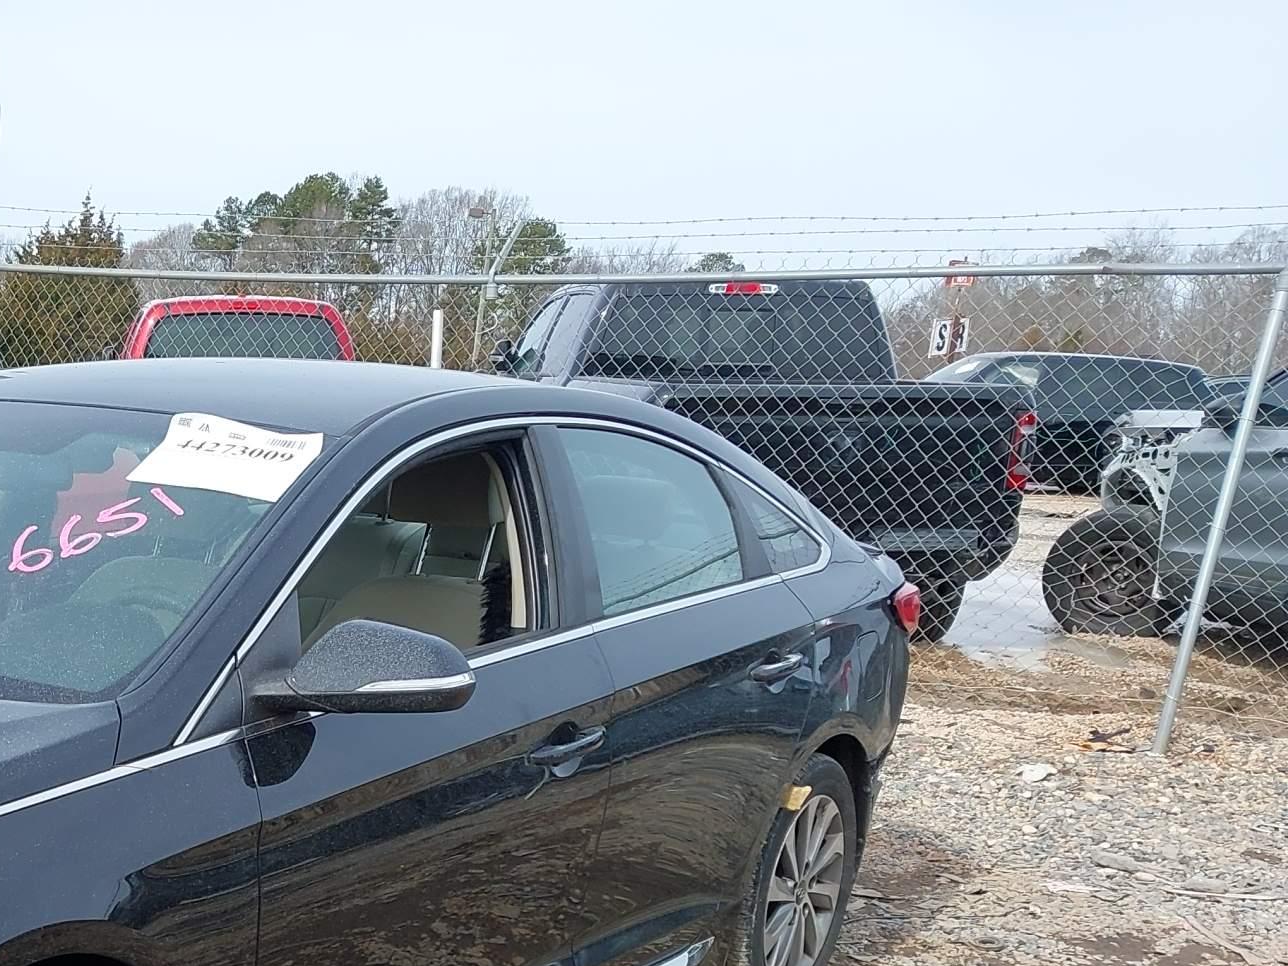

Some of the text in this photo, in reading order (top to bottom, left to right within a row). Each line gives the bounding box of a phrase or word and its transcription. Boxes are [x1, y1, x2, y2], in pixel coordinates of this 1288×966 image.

[936, 323, 948, 352] S
[177, 439, 295, 462] 44273009
[8, 487, 185, 573] 6651
